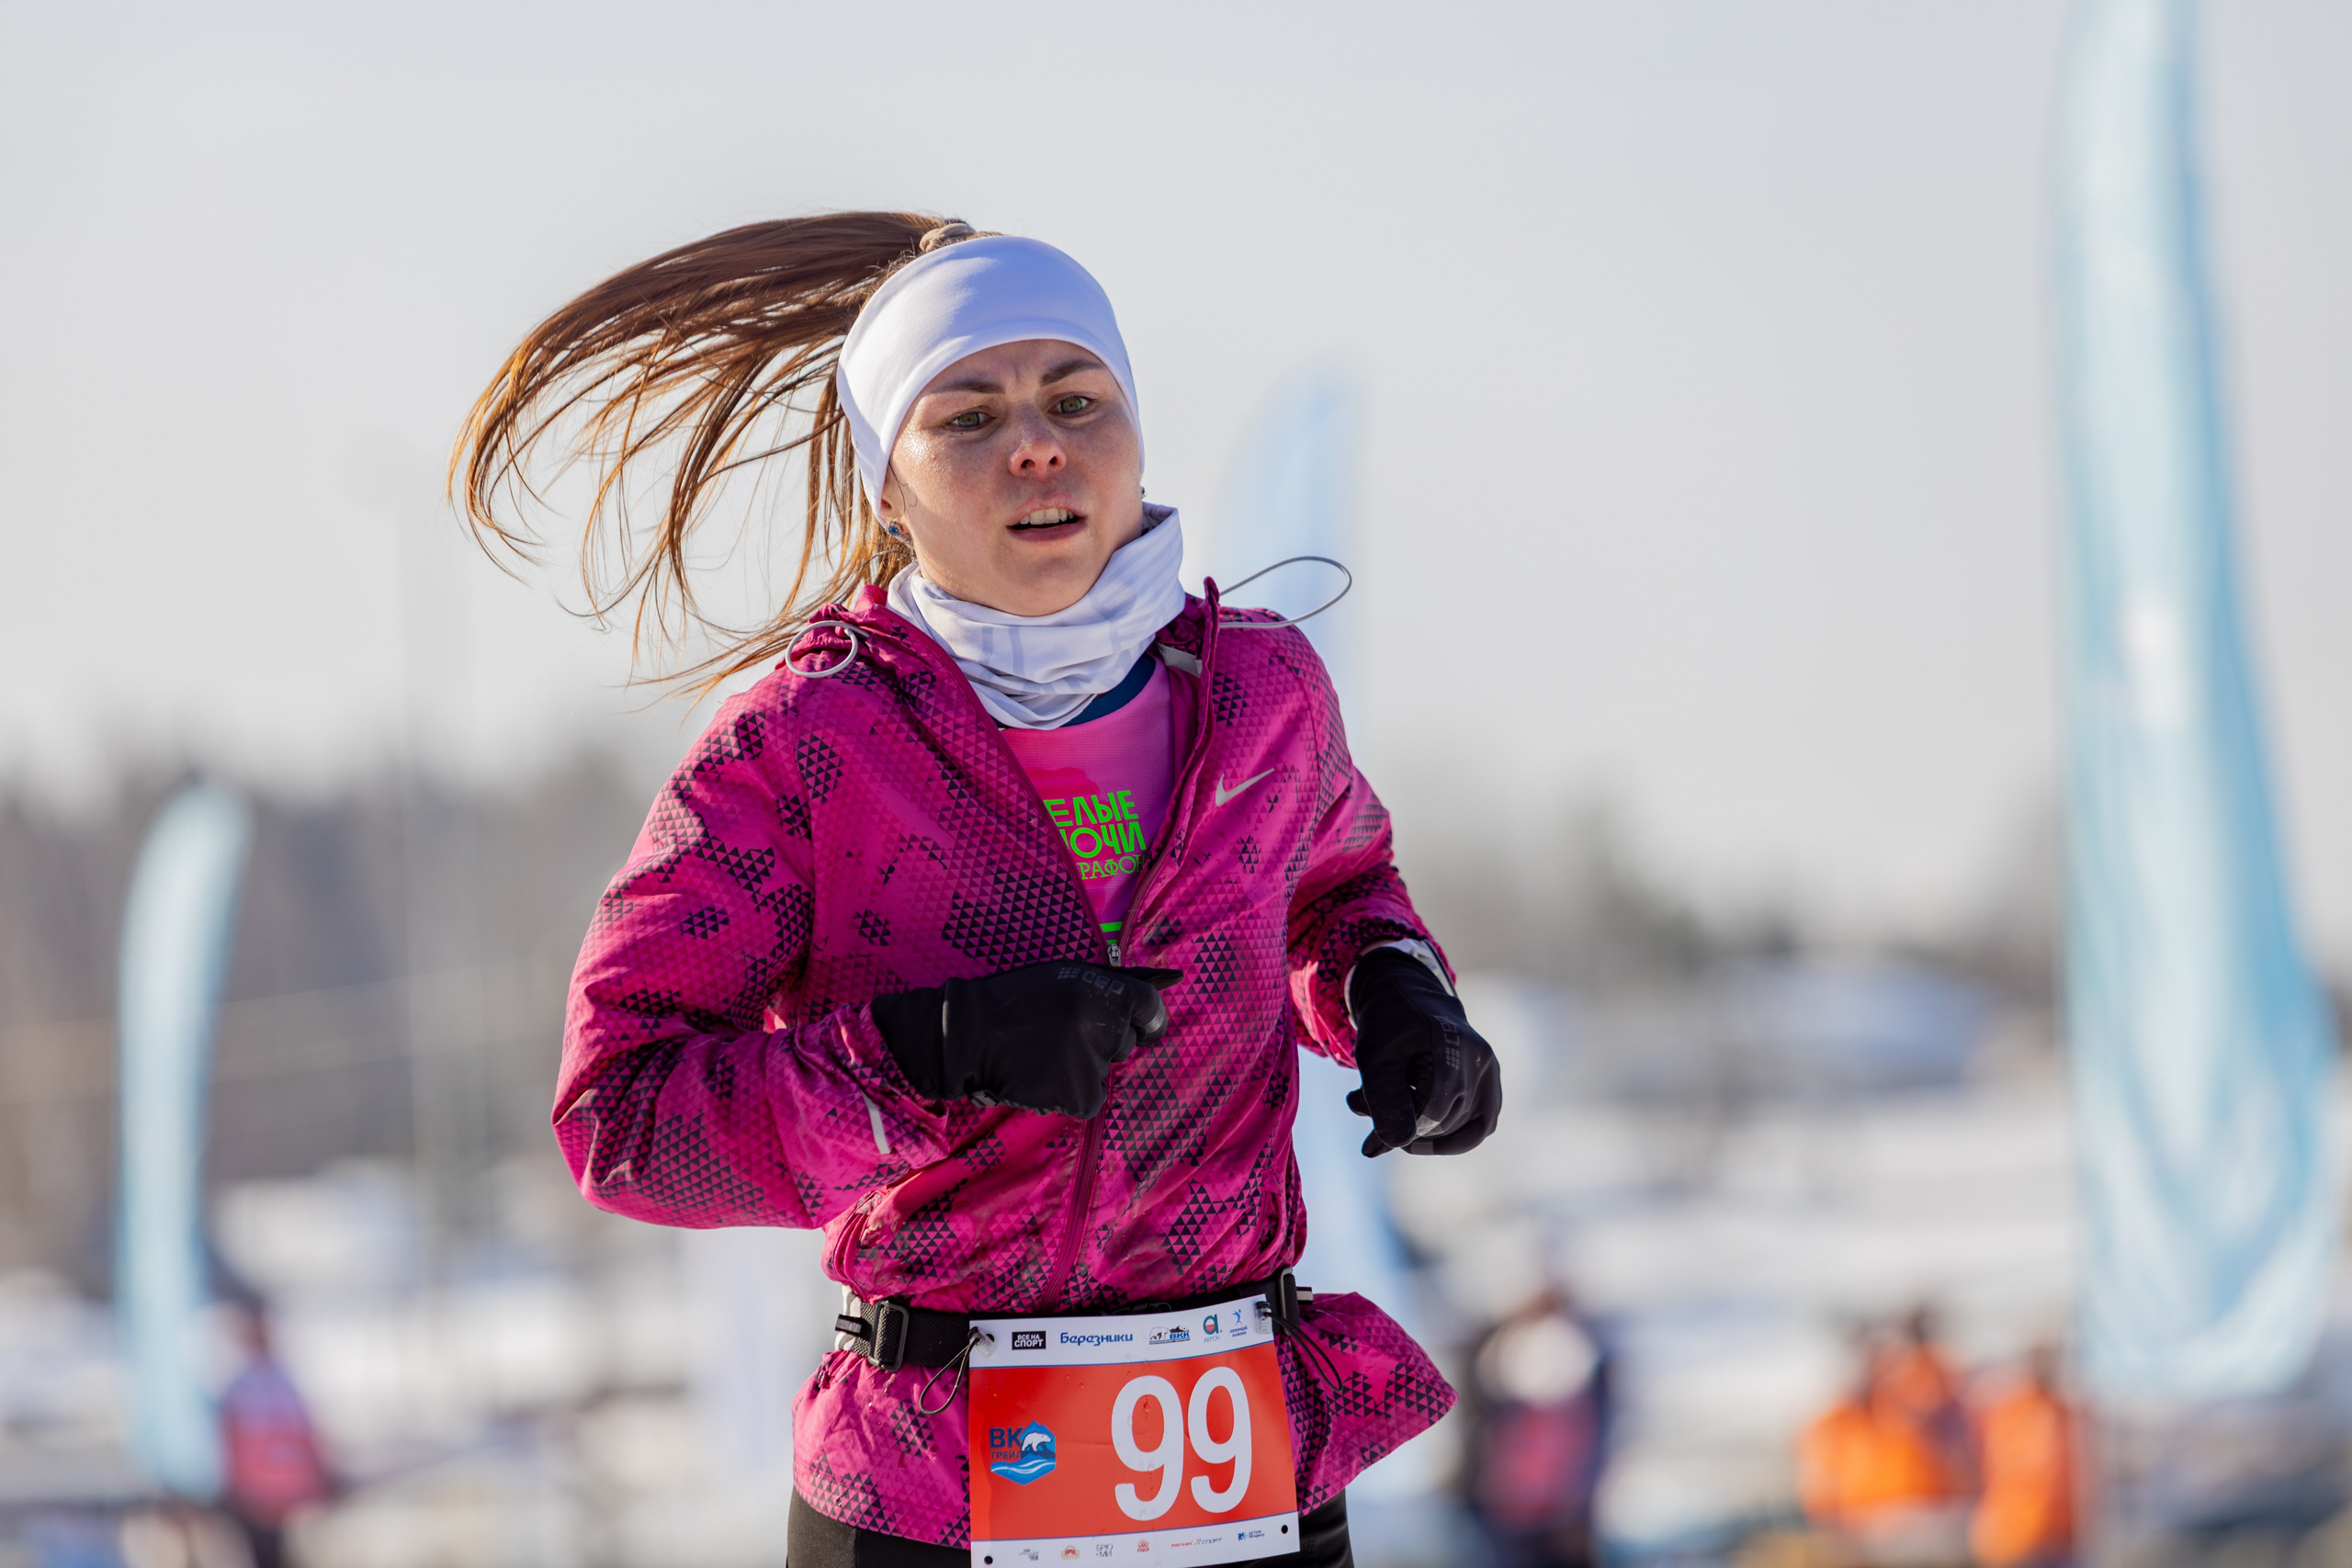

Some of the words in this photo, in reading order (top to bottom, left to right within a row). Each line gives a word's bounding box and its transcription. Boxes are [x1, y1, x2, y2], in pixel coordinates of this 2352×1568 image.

[1013, 1338, 1044, 1348] СПОРТ
[1060, 1332, 1134, 1347] Березники
[989, 1427, 1023, 1449] ВК
[1111, 1366, 1252, 1521] 99
